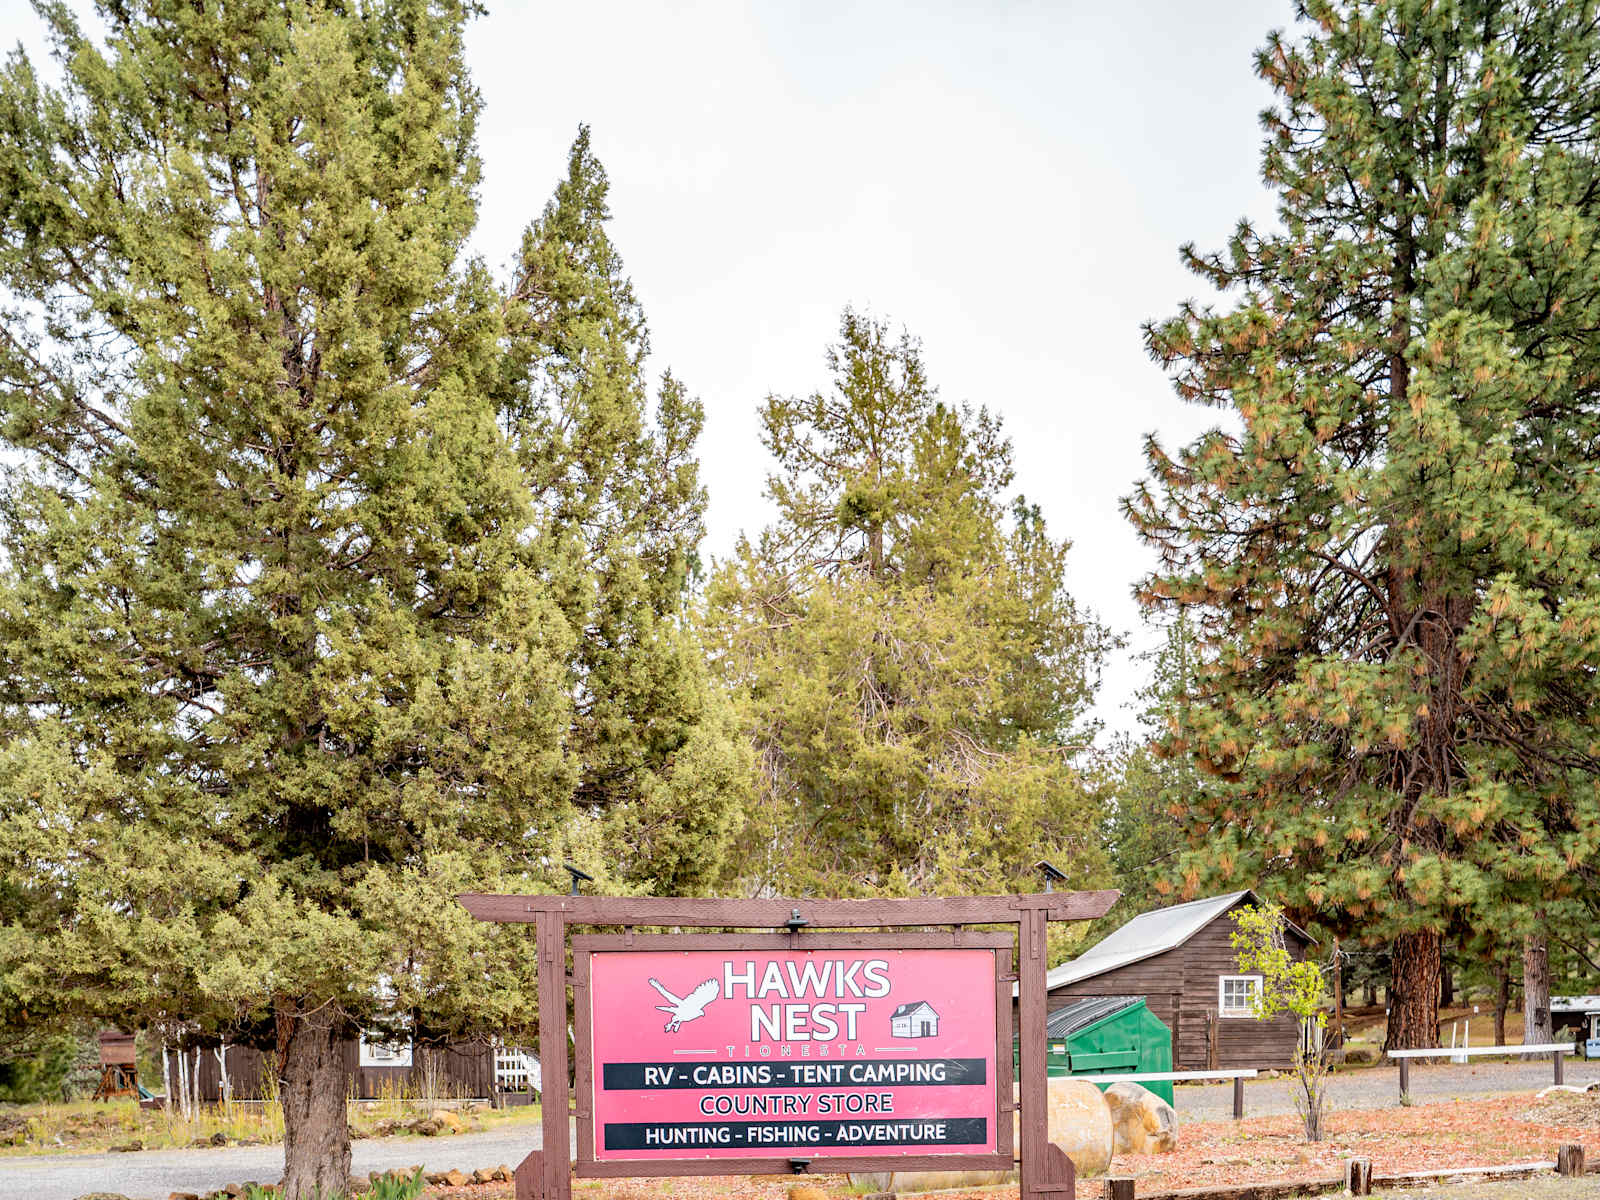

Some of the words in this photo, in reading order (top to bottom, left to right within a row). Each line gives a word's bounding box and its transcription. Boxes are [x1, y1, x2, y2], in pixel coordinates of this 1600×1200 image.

[723, 960, 891, 999] HAWKS
[751, 1003, 866, 1042] NEST
[726, 1044, 866, 1057] TIONESTA
[645, 1067, 674, 1085] RV
[692, 1065, 772, 1085] CABINS
[791, 1064, 844, 1082] TENT
[848, 1063, 946, 1082] CAMPING
[700, 1095, 813, 1115] COUNTRY
[818, 1093, 893, 1113] STORE
[646, 1127, 730, 1144] HUNTING
[747, 1126, 820, 1143] FISHING
[836, 1125, 946, 1142] ADVENTURE
